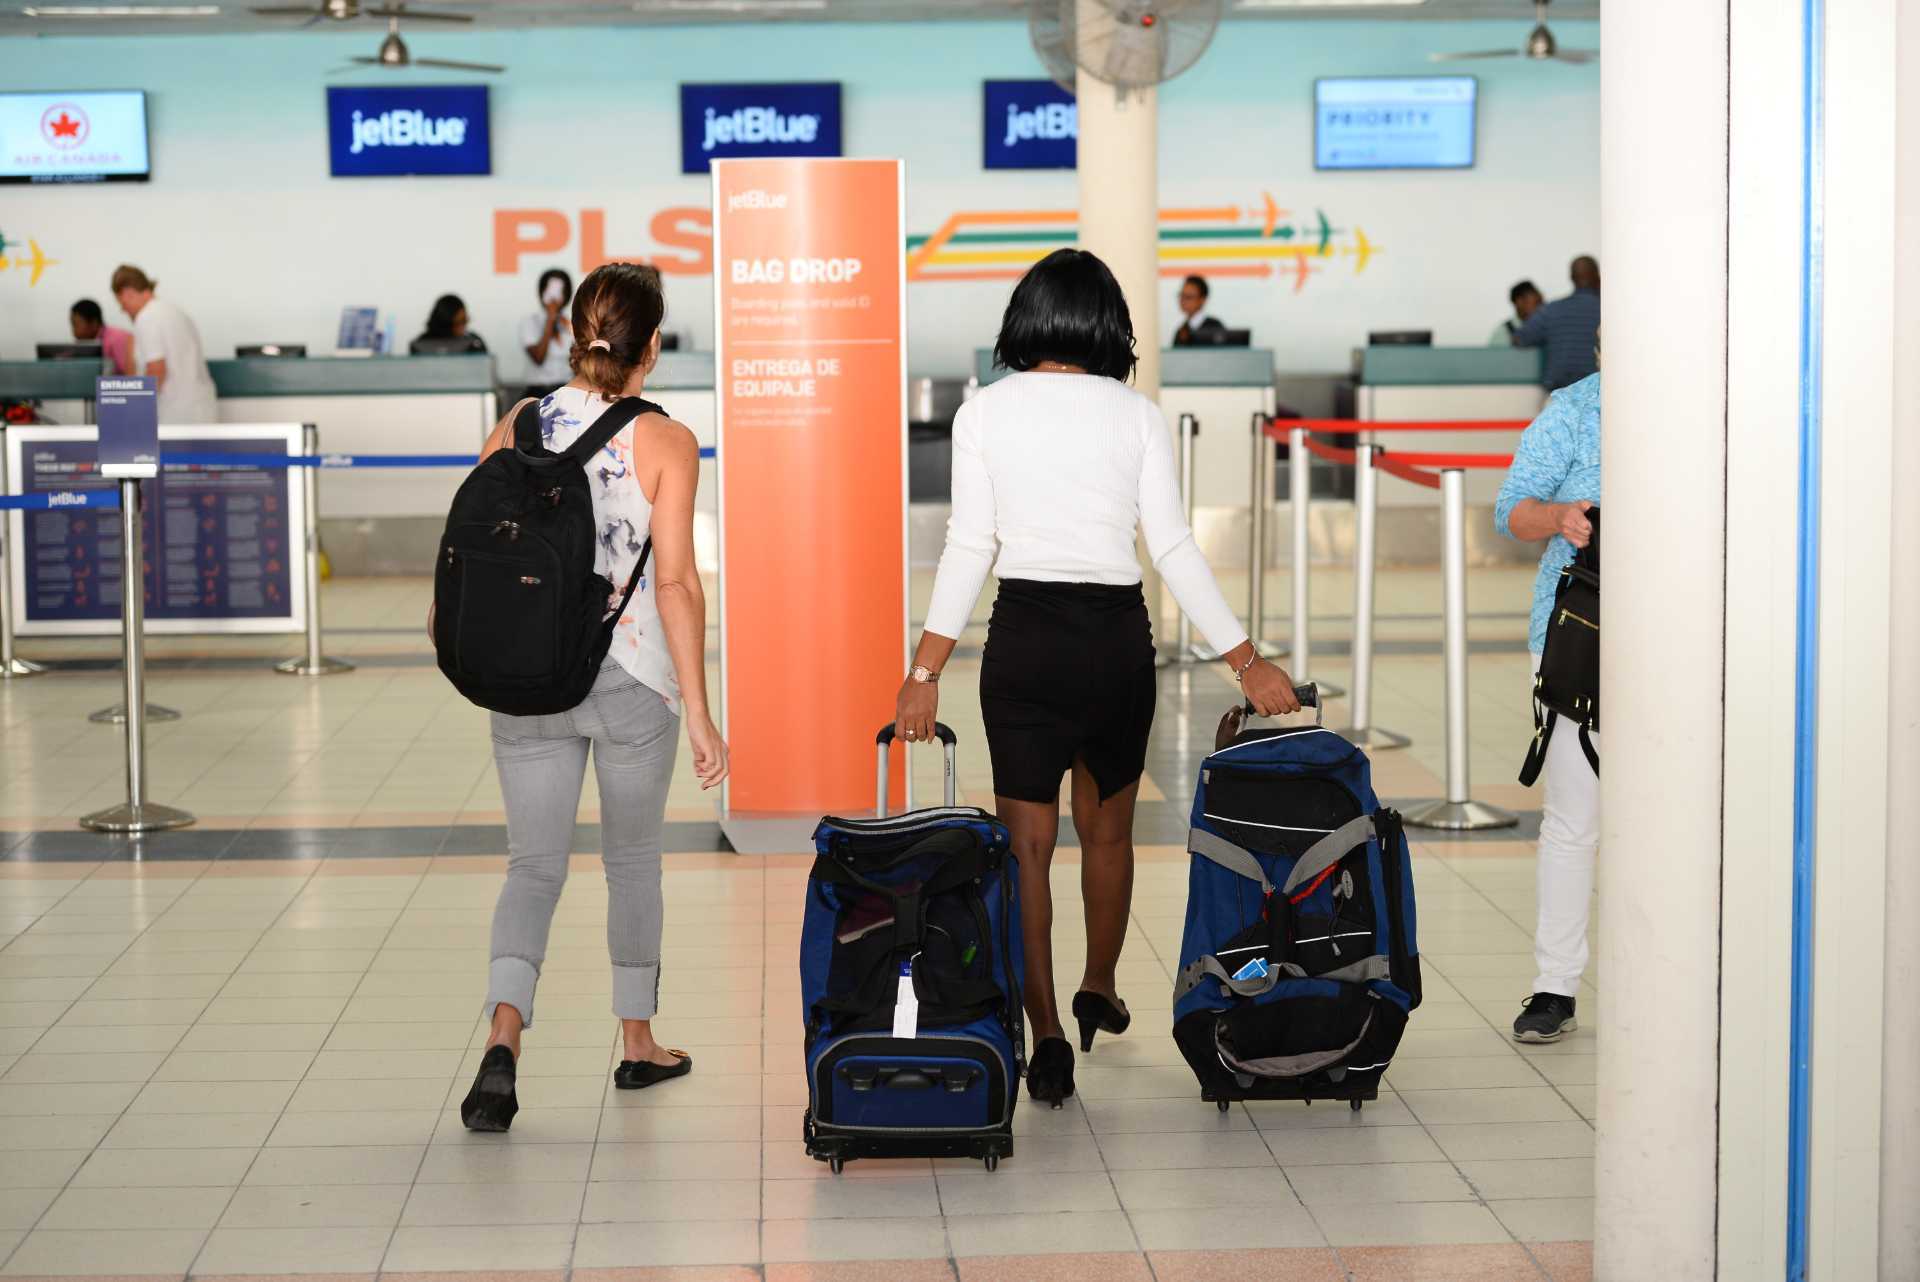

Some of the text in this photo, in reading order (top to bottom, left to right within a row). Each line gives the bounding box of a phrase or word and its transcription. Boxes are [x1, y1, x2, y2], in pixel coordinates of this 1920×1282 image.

[350, 110, 467, 154] jetBlue
[702, 107, 819, 150] jetBlue
[1003, 103, 1076, 146] jetBl
[728, 189, 788, 212] jetBlue
[493, 208, 714, 276] PLS
[731, 258, 862, 284] BAG DROP
[732, 358, 842, 377] ENTREGA DE
[733, 380, 816, 398] EQUIPAJE
[48, 492, 87, 508] jetBlue
